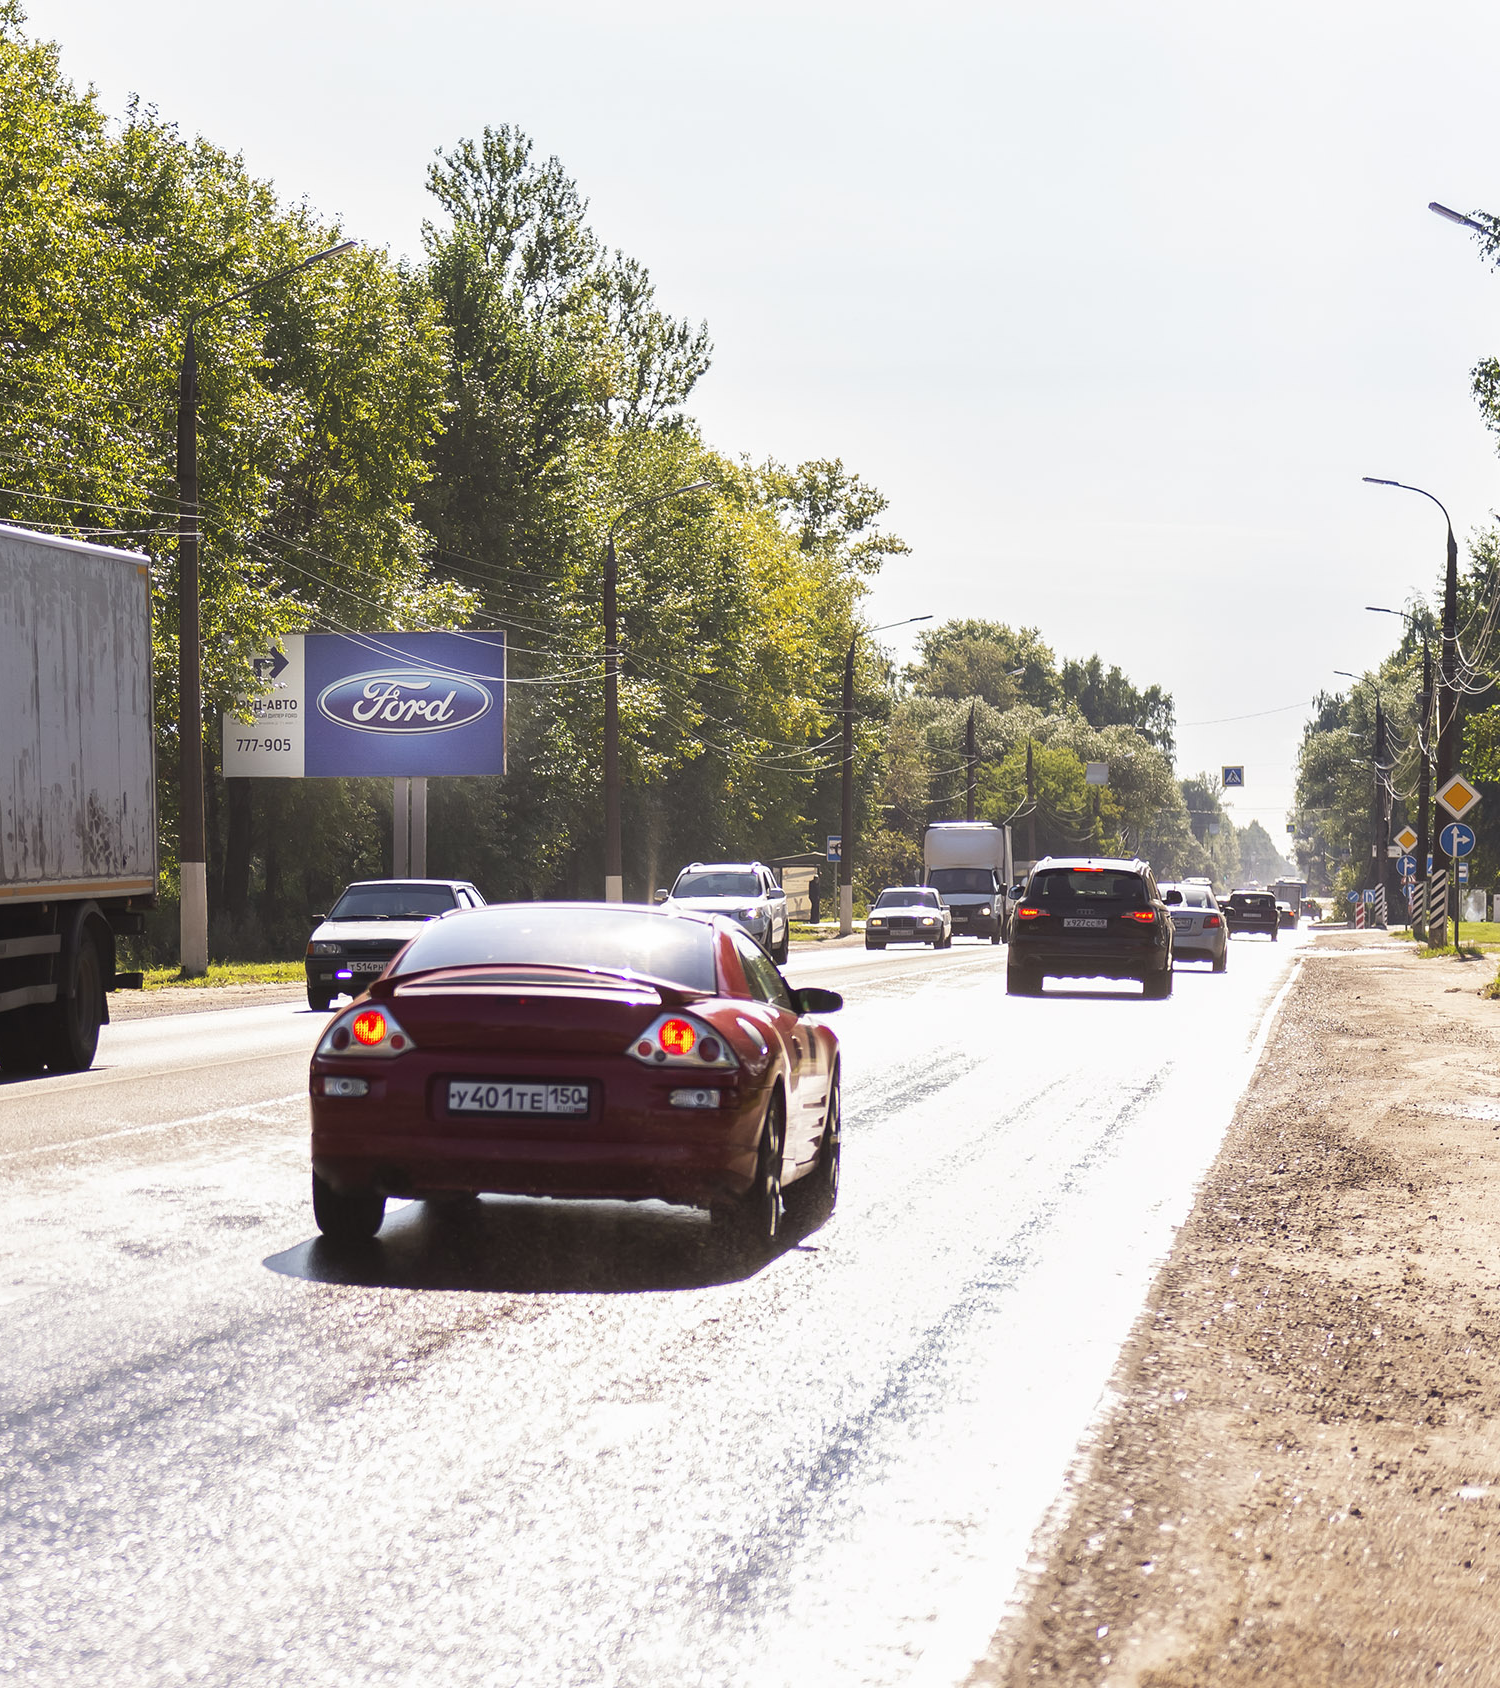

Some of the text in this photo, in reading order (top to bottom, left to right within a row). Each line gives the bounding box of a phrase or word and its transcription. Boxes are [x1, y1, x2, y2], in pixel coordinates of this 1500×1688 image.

[353, 679, 455, 722] Ford
[236, 738, 291, 752] 777-905
[456, 1085, 584, 1111] У401ТЕ 150
